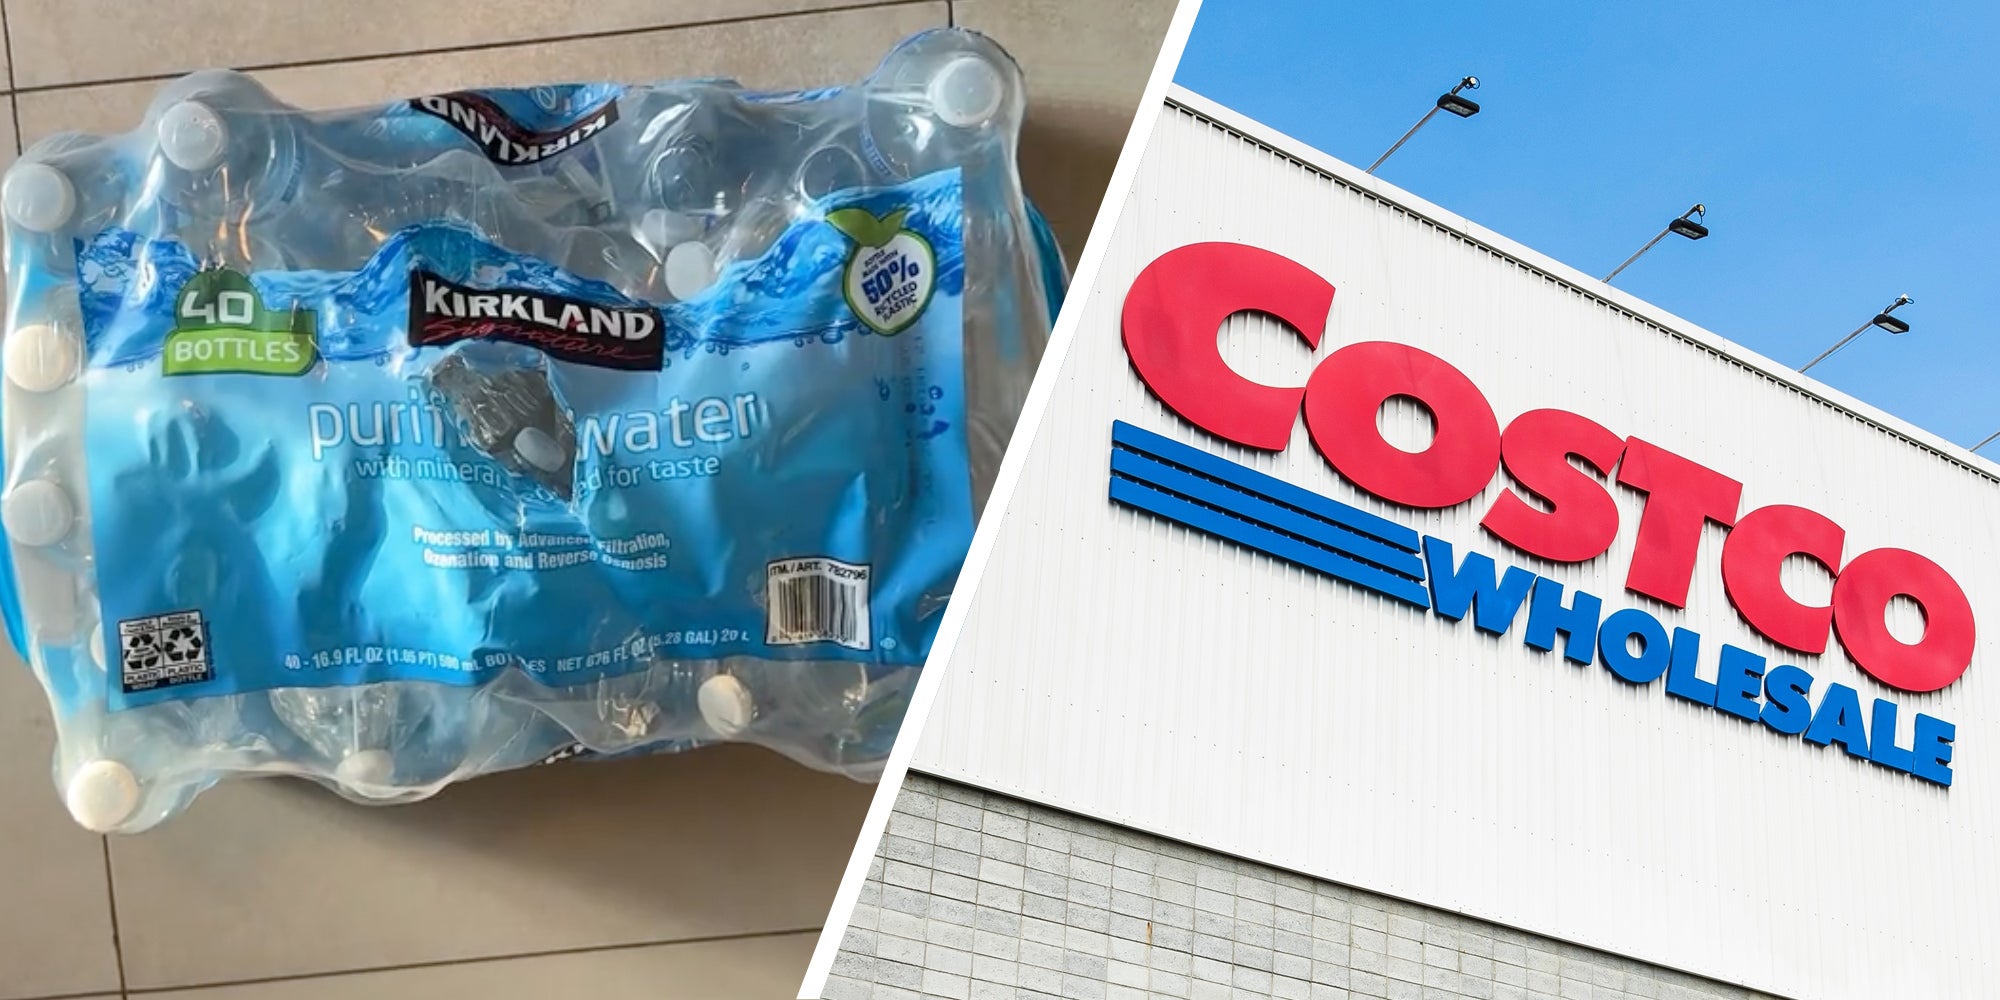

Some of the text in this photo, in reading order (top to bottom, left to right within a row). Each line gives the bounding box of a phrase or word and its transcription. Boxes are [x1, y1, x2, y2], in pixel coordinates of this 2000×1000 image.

[861, 253, 920, 305] 50%
[180, 290, 254, 325] 40
[424, 279, 656, 341] KIRKLAND
[174, 336, 301, 363] BOTTLES
[356, 453, 409, 478] with
[607, 464, 642, 487] for
[649, 455, 720, 480] taste
[1121, 241, 1976, 692] COSTCO
[413, 527, 489, 547] Processed
[494, 530, 513, 549] by
[597, 533, 670, 555] Filtration,
[424, 549, 499, 567] Ozonation
[504, 554, 533, 568] and
[538, 550, 598, 568] Reverse
[284, 655, 301, 669] 40
[312, 650, 343, 668] 16.9
[345, 650, 362, 663] FL
[365, 648, 383, 662] OZ
[557, 656, 581, 672] NET
[613, 646, 628, 663] FL
[685, 630, 717, 645] GAL)
[721, 628, 738, 642] 20
[1421, 535, 1956, 787] WHOLESALE
